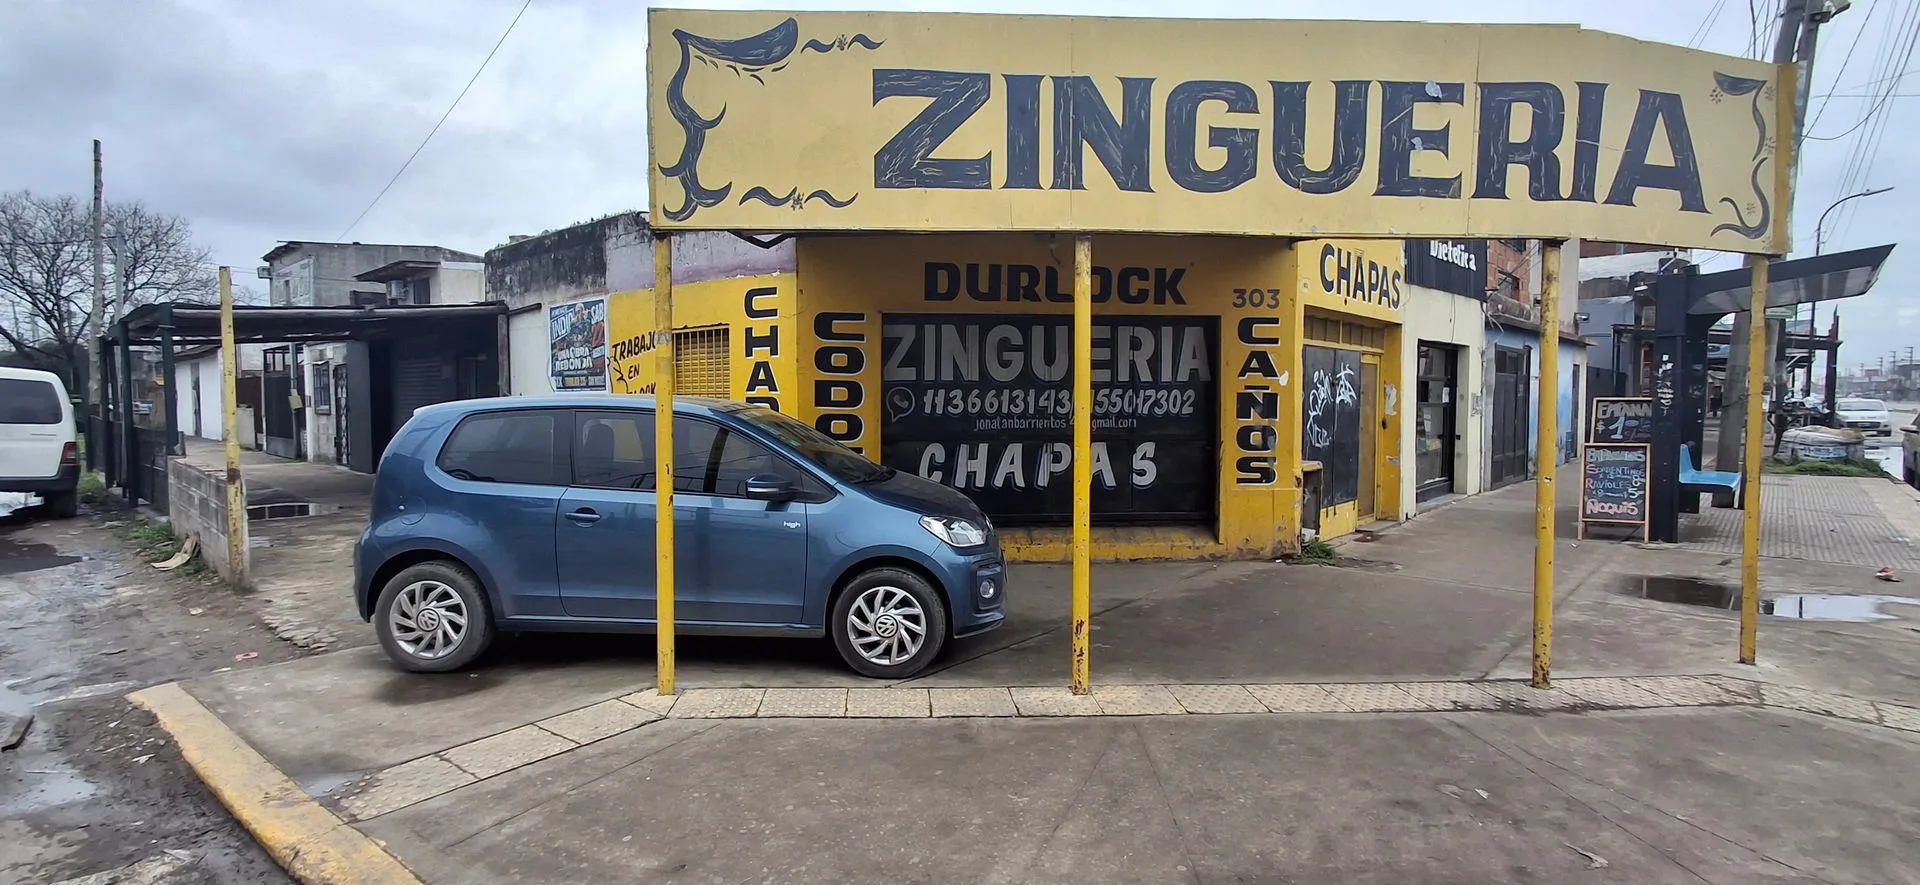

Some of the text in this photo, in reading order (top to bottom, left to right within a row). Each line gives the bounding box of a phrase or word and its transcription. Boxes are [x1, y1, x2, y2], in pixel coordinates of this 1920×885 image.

[872, 68, 1712, 214] ZINGUERIA
[924, 262, 1187, 305] DURLOCK
[1232, 288, 1280, 309] 303
[1320, 243, 1401, 309] CHAPAS
[628, 364, 640, 380] EN
[884, 324, 1212, 382] ZINGUERIA
[813, 312, 867, 455] CODO
[1236, 317, 1280, 486] CAÑOS
[918, 441, 1158, 490] CHAPAS
[783, 520, 801, 529] high
